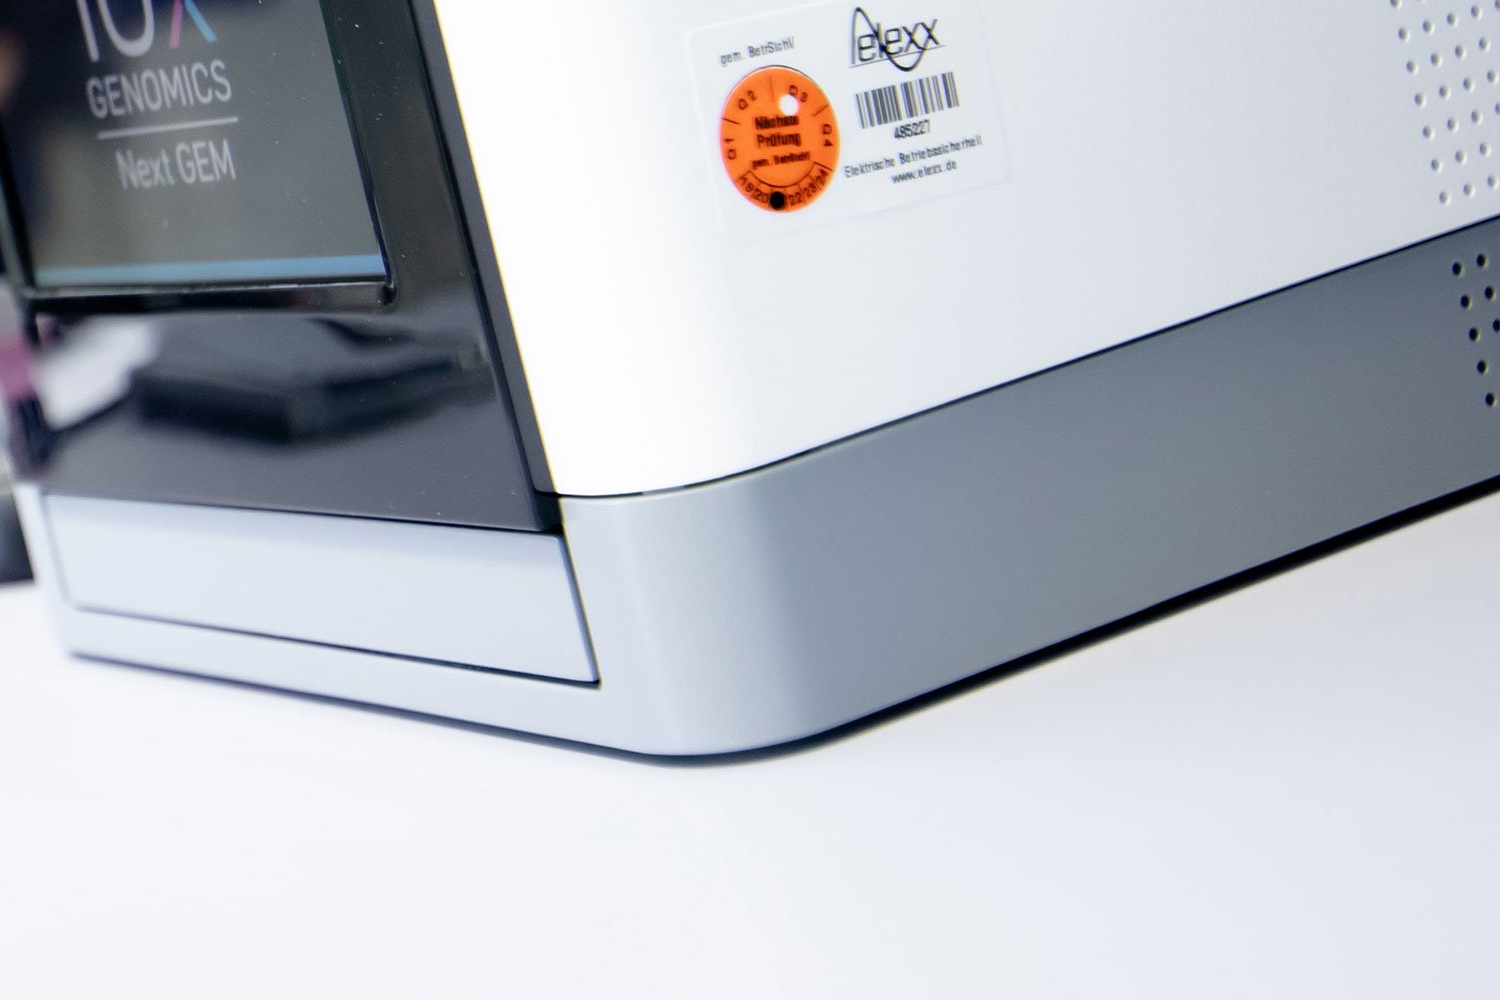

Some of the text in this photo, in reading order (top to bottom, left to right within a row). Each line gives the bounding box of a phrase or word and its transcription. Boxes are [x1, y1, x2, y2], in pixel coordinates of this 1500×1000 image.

[85, 59, 232, 120] GENOMICS
[757, 132, 802, 149] Prüfung
[894, 119, 931, 140] 485227
[115, 138, 237, 190] Next GEM
[844, 134, 983, 178] Elektrische Betriebssicherheit
[891, 160, 958, 184] www.elexx.de
